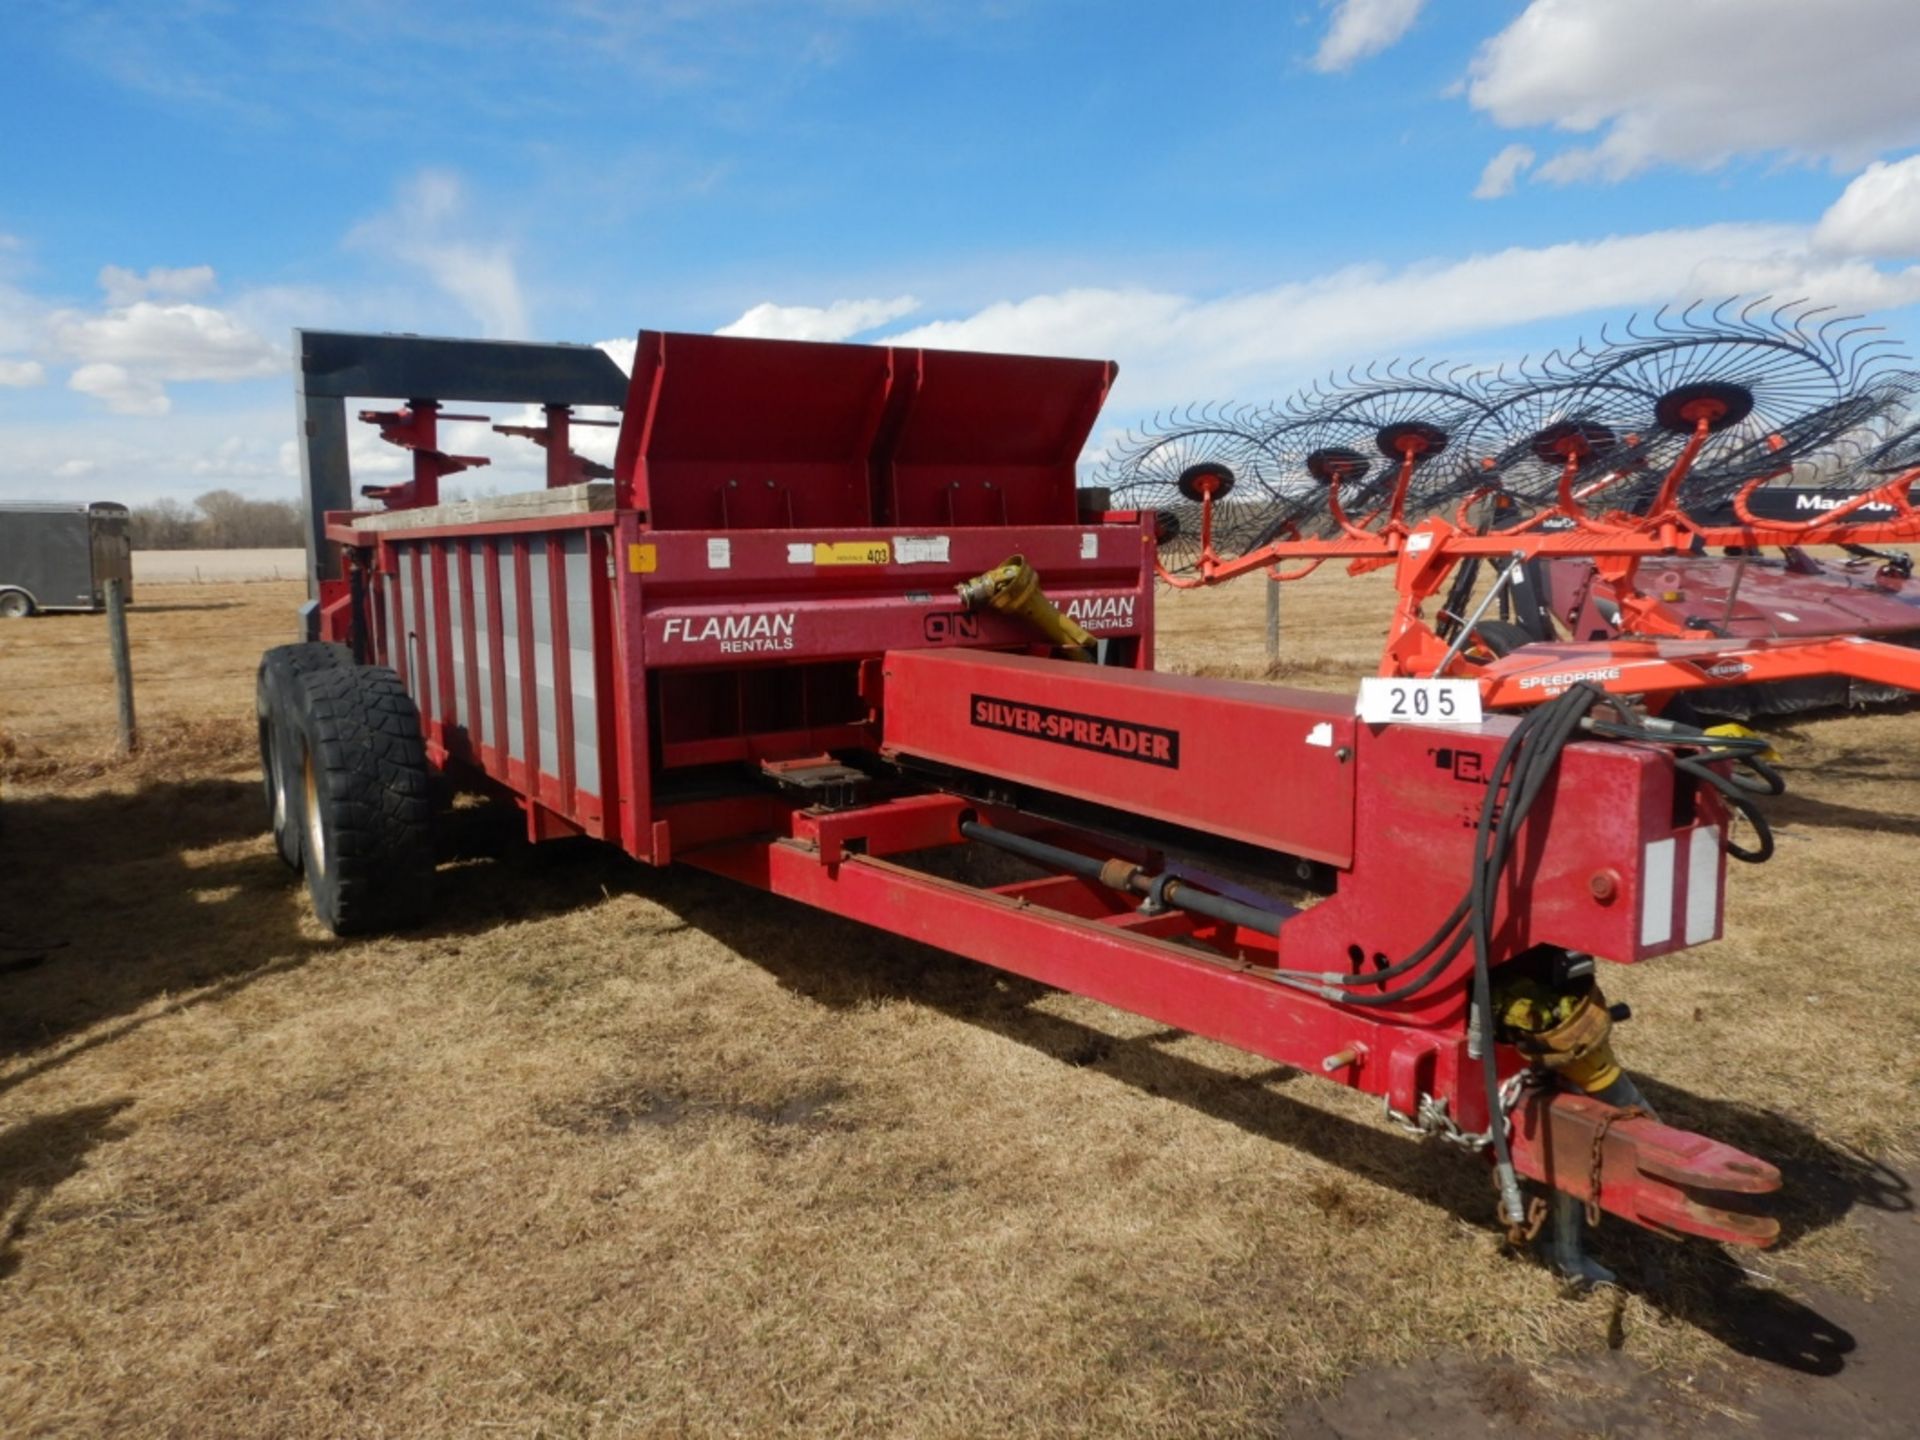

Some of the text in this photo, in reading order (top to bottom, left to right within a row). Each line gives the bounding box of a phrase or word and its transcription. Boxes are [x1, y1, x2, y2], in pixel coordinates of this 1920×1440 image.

[867, 549, 888, 564] 403
[1049, 596, 1135, 619] AMAN
[663, 613, 795, 643] FLAMAN
[1080, 617, 1134, 631] RENTALS
[720, 637, 794, 653] RENTALS
[1519, 668, 1620, 689] SPEEDRAKE
[1390, 686, 1456, 717] 205
[976, 700, 1170, 760] SILVER-SPREADER
